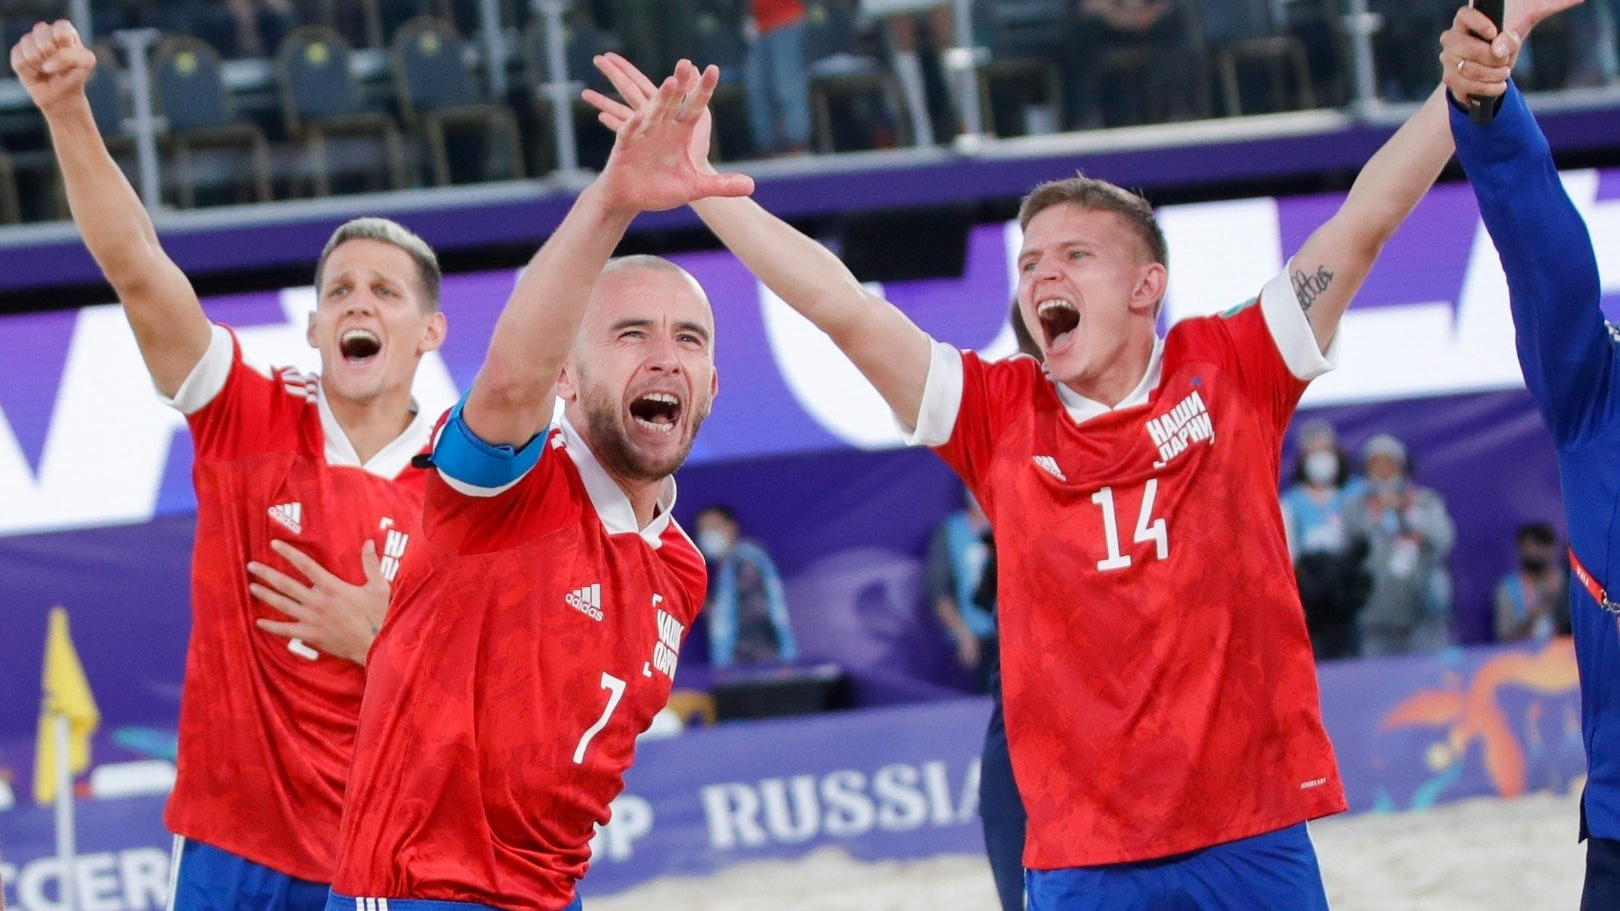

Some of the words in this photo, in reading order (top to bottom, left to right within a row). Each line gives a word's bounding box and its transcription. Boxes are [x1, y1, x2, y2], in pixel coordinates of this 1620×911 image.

[1146, 390, 1206, 447] НАШИ
[1159, 412, 1213, 462] ПАРНИ
[1092, 479, 1168, 571] 14
[565, 593, 604, 622] adidas
[573, 671, 626, 765] 7
